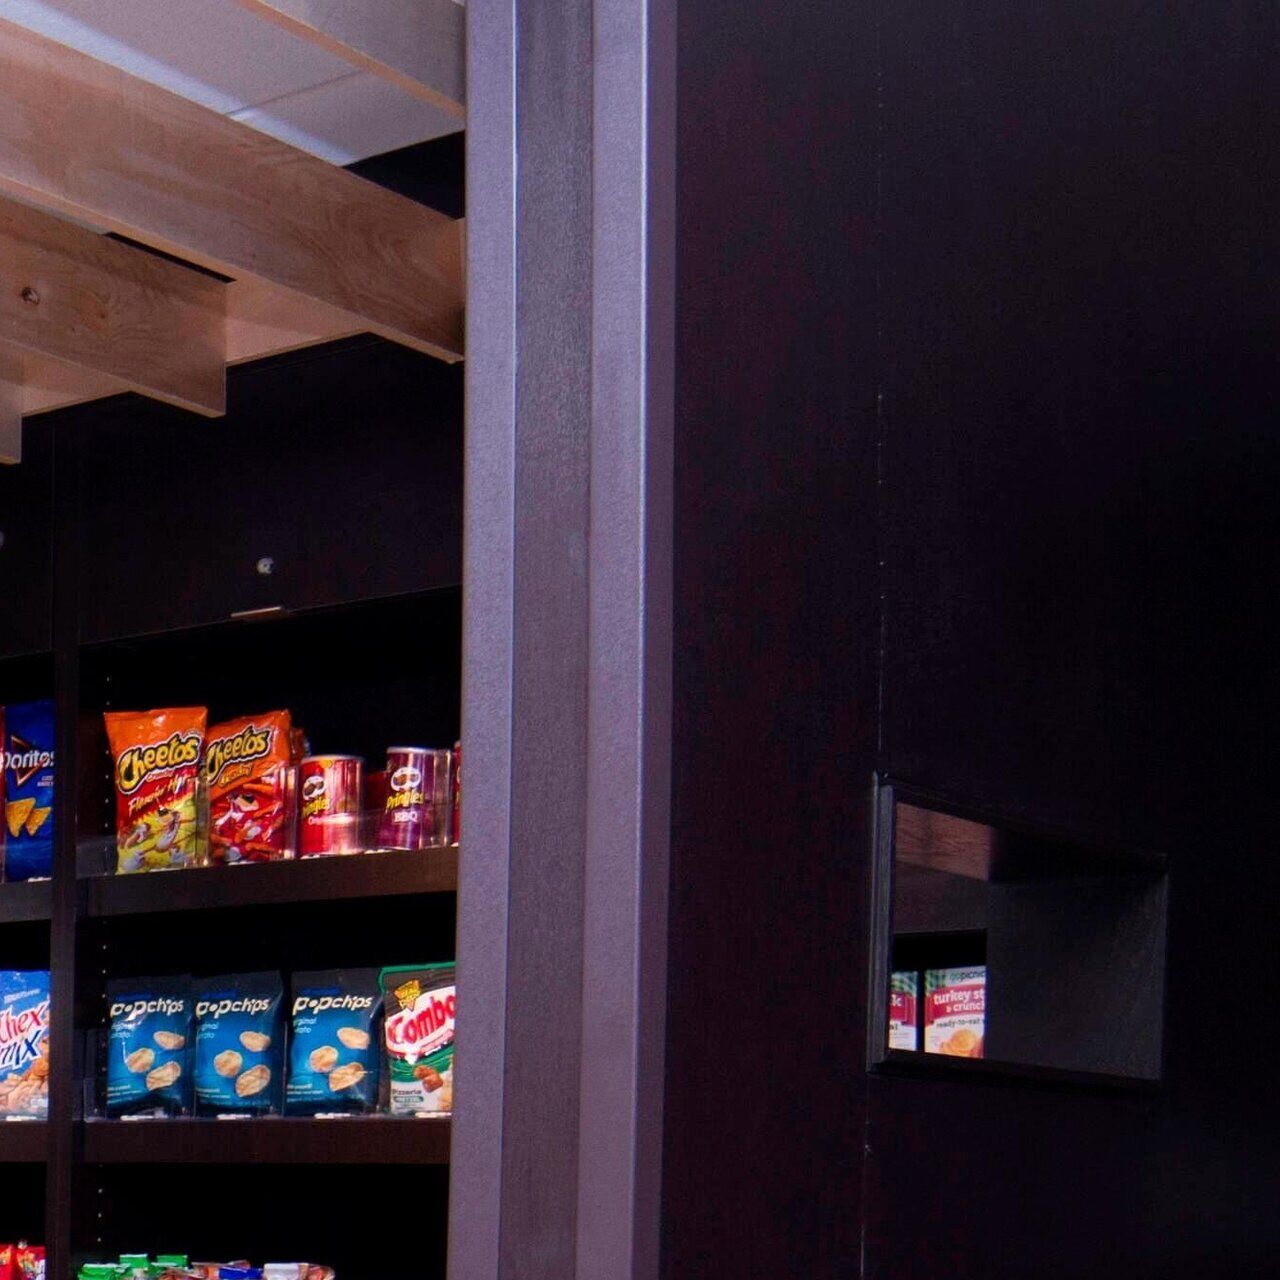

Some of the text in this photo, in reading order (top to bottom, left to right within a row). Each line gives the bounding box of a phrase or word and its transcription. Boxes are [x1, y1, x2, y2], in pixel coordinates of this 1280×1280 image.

[118, 734, 201, 793] Cheetos
[205, 726, 272, 784] Cheetos
[386, 790, 424, 814] Pringles
[394, 811, 418, 823] BBQ
[292, 995, 374, 1016] popchips
[933, 989, 971, 1005] turkey
[110, 998, 185, 1019] popchips
[196, 998, 270, 1019] popchips
